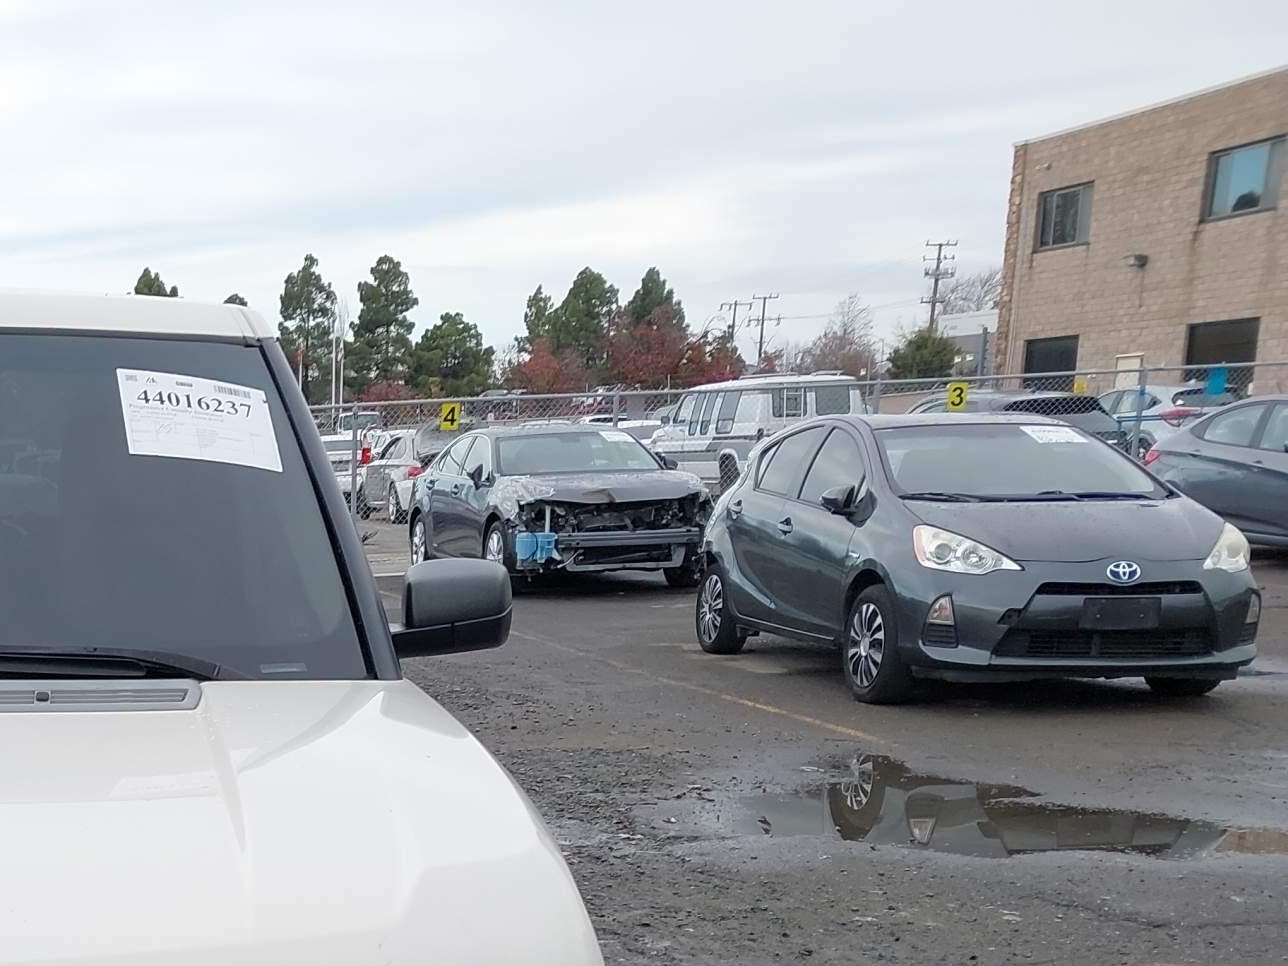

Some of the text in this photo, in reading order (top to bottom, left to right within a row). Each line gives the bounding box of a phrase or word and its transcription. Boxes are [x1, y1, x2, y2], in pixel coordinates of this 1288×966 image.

[137, 388, 252, 418] 44016237
[951, 386, 963, 406] 3
[443, 406, 457, 426] 4
